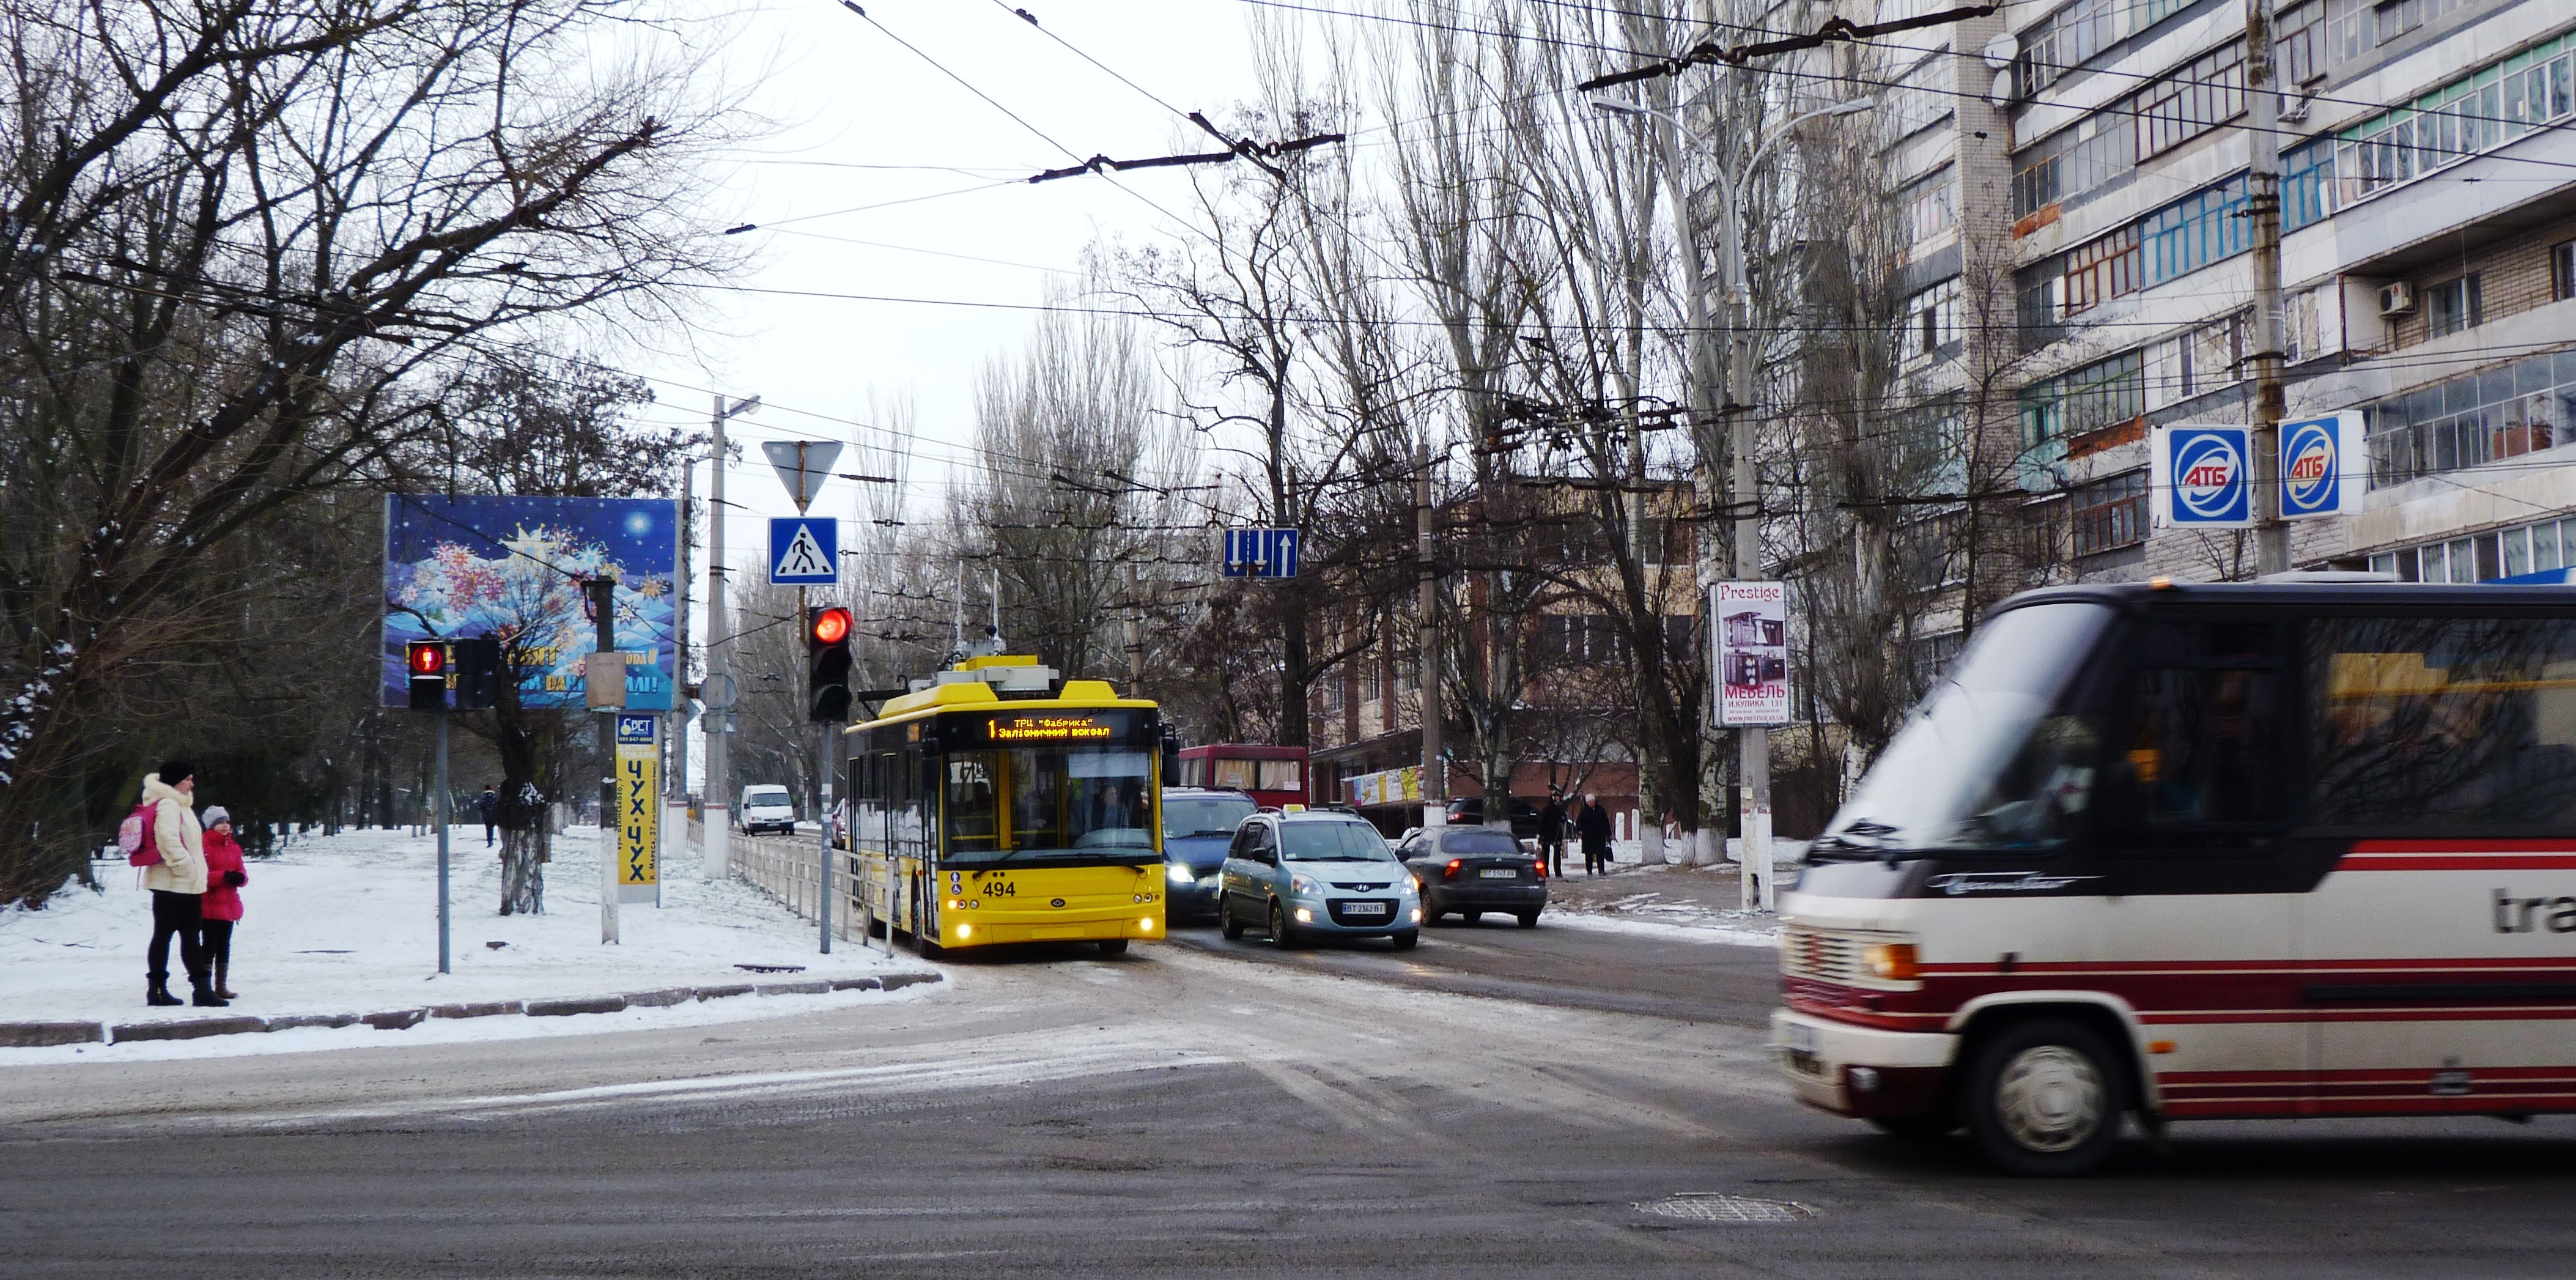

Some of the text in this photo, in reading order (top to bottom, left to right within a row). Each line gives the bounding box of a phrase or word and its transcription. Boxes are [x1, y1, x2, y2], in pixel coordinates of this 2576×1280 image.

[2290, 455, 2325, 479] АТБ
[2184, 466, 2227, 486] АТБ
[1720, 585, 1780, 602] Prestige
[1725, 684, 1785, 699] МЕБЕЛЬ
[988, 719, 995, 738] 1
[1014, 719, 1033, 728] ТРЦ
[982, 881, 1016, 897] 494
